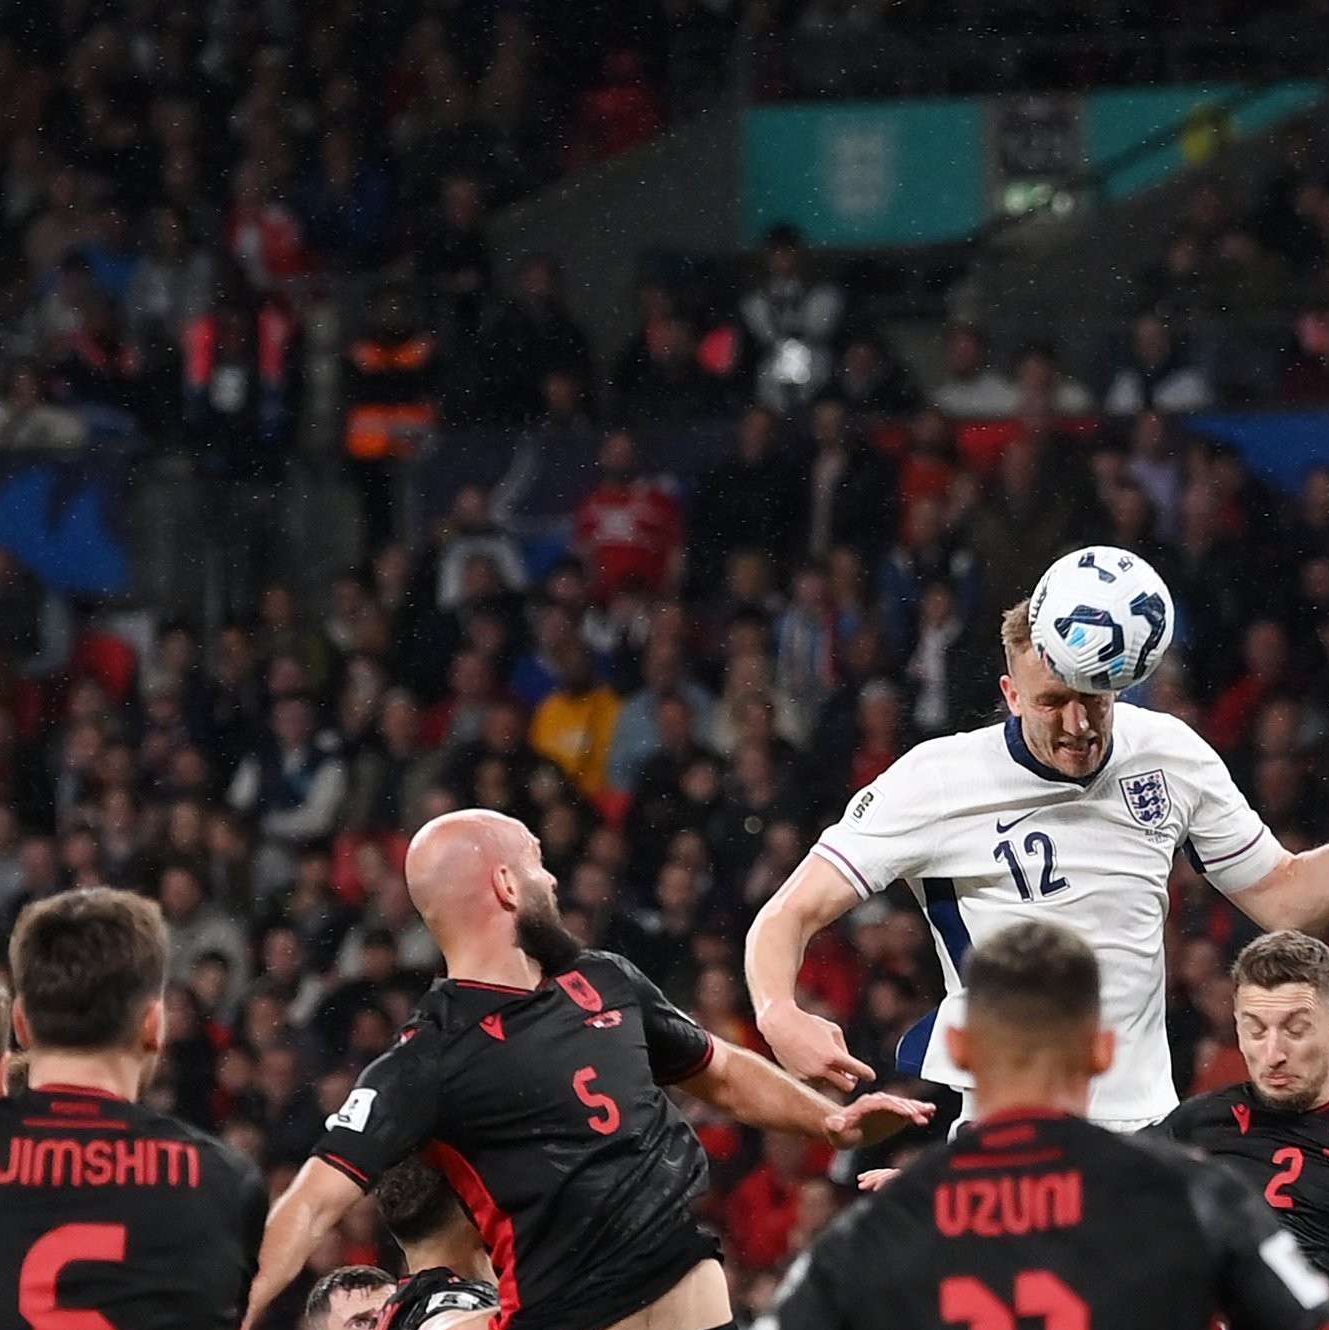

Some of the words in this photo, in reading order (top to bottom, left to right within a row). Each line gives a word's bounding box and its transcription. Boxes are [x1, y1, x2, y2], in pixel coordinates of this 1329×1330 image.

[992, 830, 1070, 902] 12
[573, 1066, 621, 1135] 5
[934, 1169, 1083, 1238] UZUNI
[1264, 1146, 1305, 1209] 2
